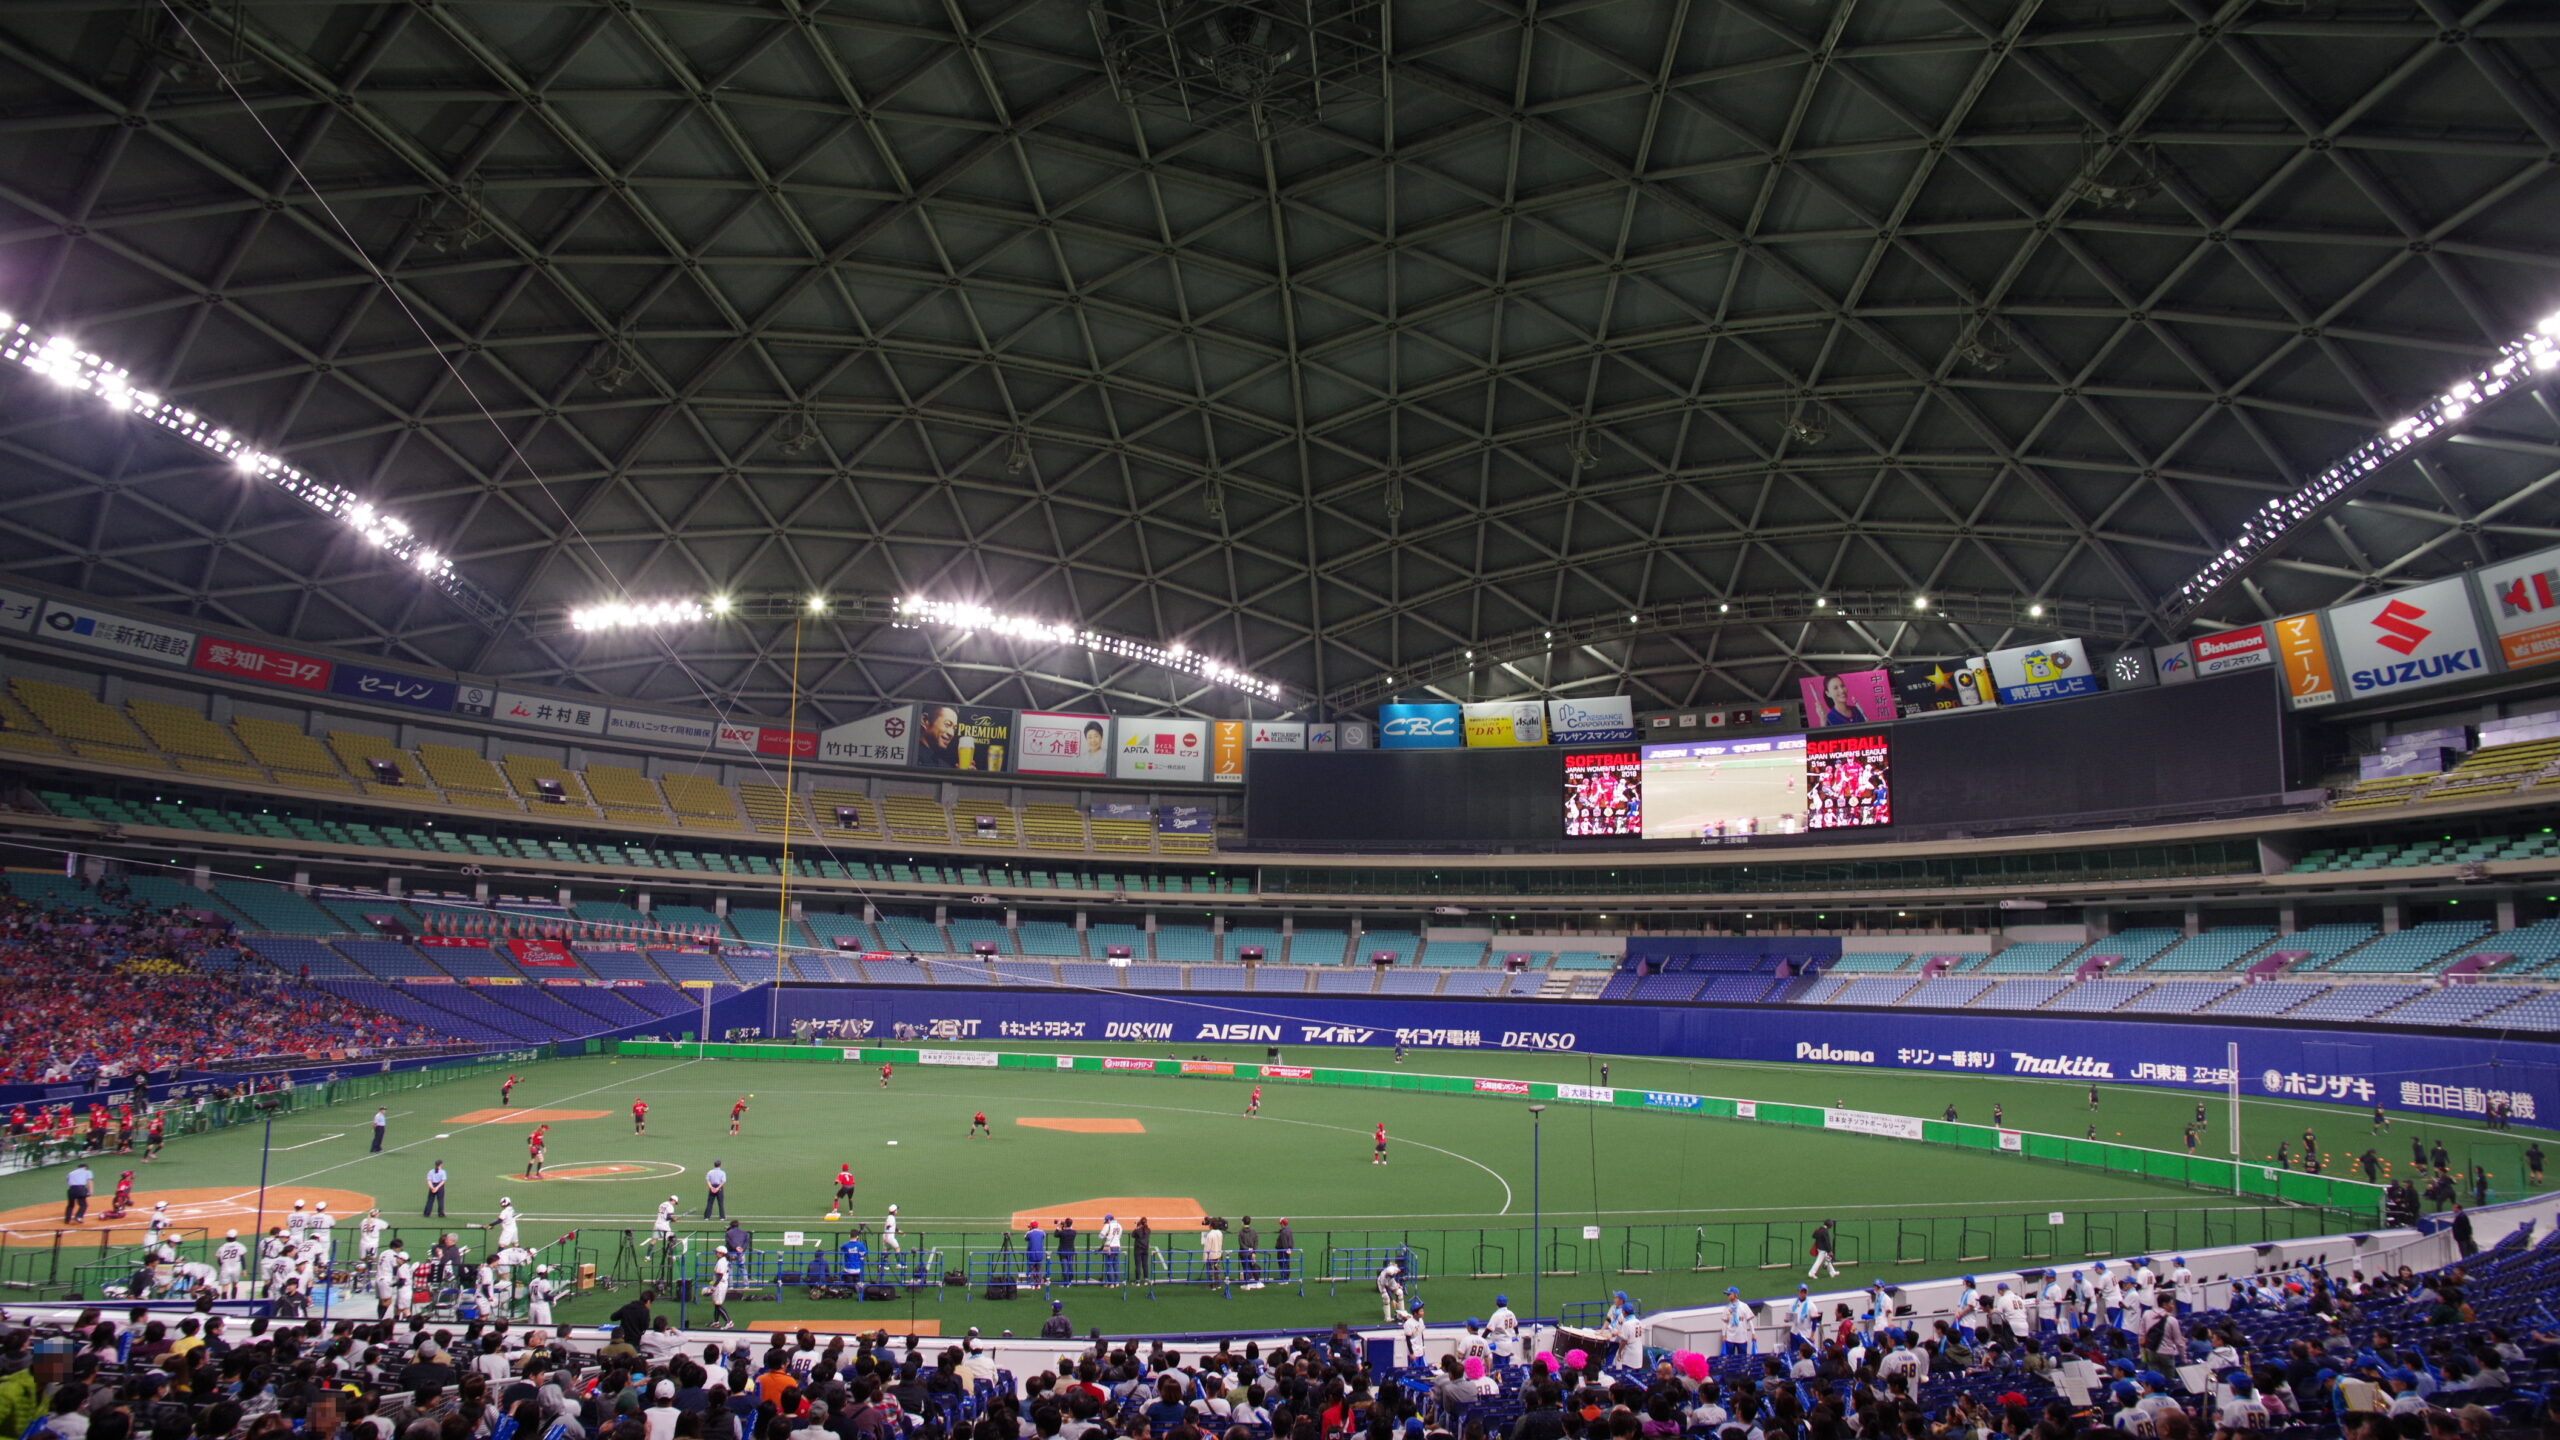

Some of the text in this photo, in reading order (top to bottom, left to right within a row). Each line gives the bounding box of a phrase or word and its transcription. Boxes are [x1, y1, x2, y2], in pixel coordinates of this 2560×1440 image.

[114, 625, 189, 657] 新和建設
[2199, 636, 2262, 656] Bishamon
[208, 644, 322, 682] 愛知トヨタ
[2287, 619, 2320, 694] マニーク
[2351, 649, 2481, 692] SUZUKI
[357, 674, 434, 700] セーレン
[1871, 675, 1890, 717] 中日新聞
[2010, 677, 2086, 701] 東海テレビ
[537, 704, 591, 726] 井村屋
[1516, 716, 1539, 726] Asahi
[1567, 718, 1624, 729] CORPORATION
[611, 718, 710, 738] あいおいニッセイ同和損保
[957, 723, 1007, 740] PREMIUM
[1384, 718, 1455, 735] CBC
[1556, 730, 1632, 742] プレサンスマンション
[1807, 735, 1888, 754] SOFTBALL
[826, 741, 904, 760] 竹中工務店
[1050, 740, 1078, 755] 介護
[1222, 722, 1236, 774] マニーク
[1807, 748, 1887, 761] JAPAN WOMEN'S LEAGUE
[1565, 752, 1641, 767] SOFTBALL
[929, 1019, 981, 1036] ZENT
[1104, 1022, 1173, 1039] DUSKIN
[1196, 1023, 1281, 1041] AISIN
[1301, 1026, 1374, 1043] アイホン
[1395, 1028, 1480, 1046] ダイコク電機
[1500, 1031, 1576, 1049] DENSO
[1796, 1042, 1874, 1063] Paloma
[1898, 1049, 1995, 1068] キリン一番搾り
[2131, 1062, 2187, 1081] JR東海
[1571, 1089, 1612, 1100] 大垣ミナモ
[2284, 1073, 2375, 1101] ホシザキ
[1829, 1115, 1906, 1130] 日本女子ソフトボールリーグ
[290, 1219, 303, 1228] 30
[312, 1220, 323, 1228] 31
[222, 1249, 238, 1259] 28
[1470, 1345, 1484, 1357] 88
[795, 1358, 811, 1370] 88
[1901, 1362, 1917, 1378] 88
[2246, 1410, 2266, 1429] 88
